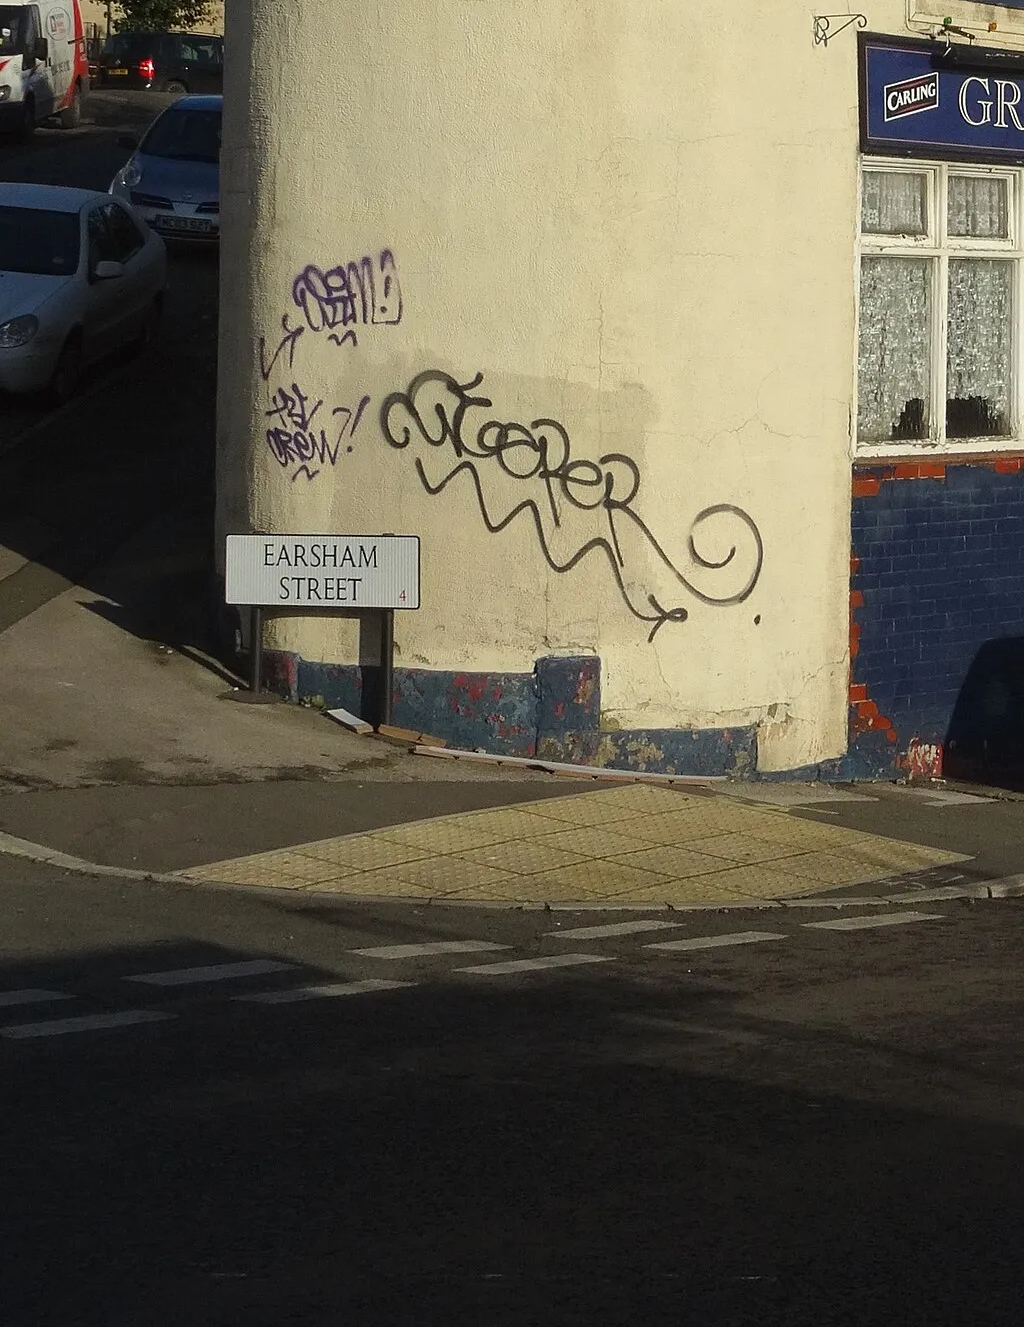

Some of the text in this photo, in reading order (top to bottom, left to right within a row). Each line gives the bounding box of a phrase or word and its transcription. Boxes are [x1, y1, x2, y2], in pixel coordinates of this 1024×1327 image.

[887, 82, 936, 111] CARLING
[263, 543, 378, 568] EARSHAM
[279, 576, 362, 601] STREET
[399, 589, 406, 602] 4
